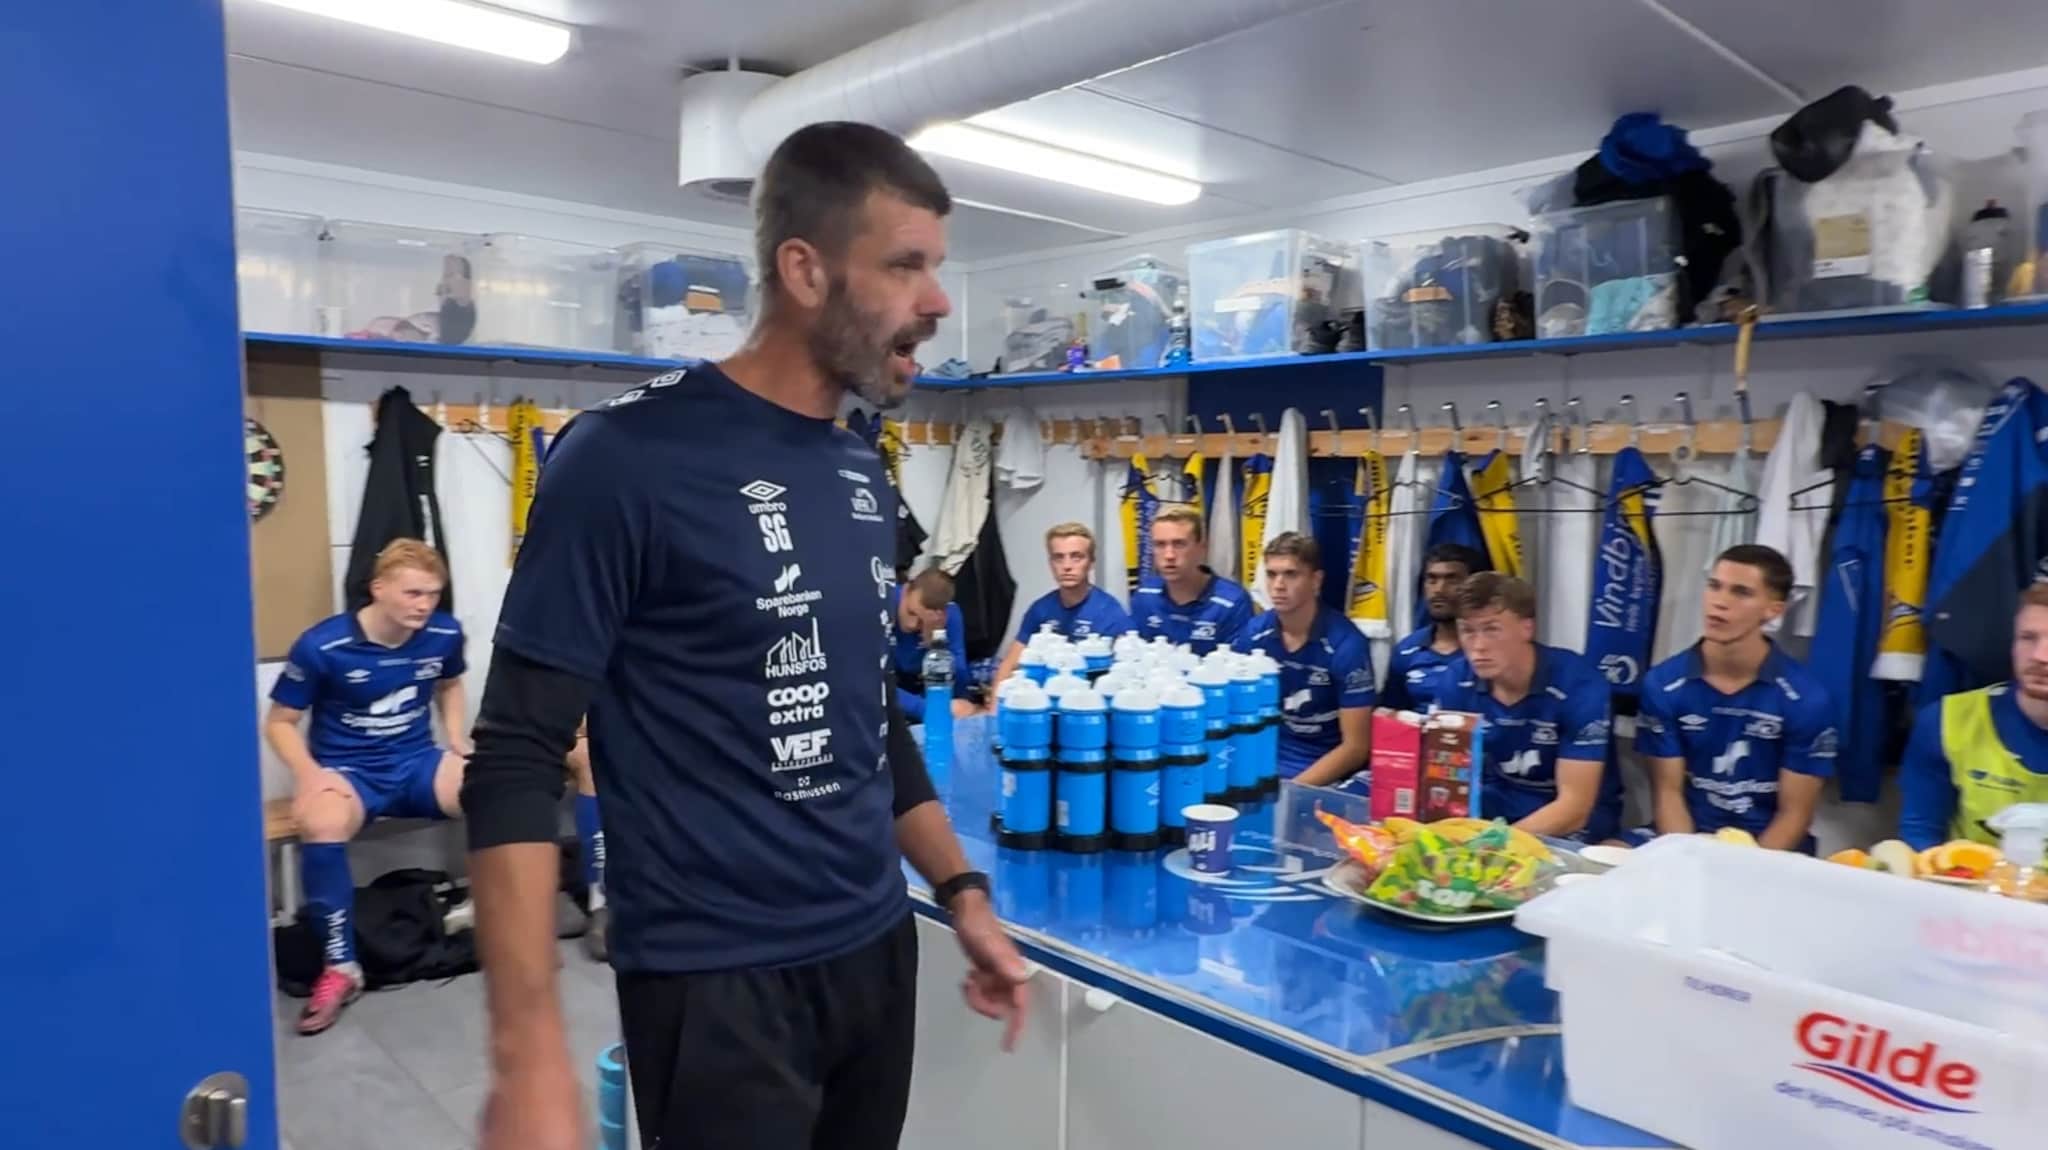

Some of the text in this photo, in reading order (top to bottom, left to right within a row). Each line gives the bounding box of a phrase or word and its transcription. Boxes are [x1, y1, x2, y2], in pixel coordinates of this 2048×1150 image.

[748, 501, 788, 514] umbro
[758, 513, 794, 552] SG
[756, 590, 823, 611] Sparebanken
[778, 603, 810, 618] Norge
[765, 657, 827, 679] HUNSFOS
[767, 681, 830, 706] coop
[769, 704, 824, 726] extra
[770, 728, 832, 762] VEF
[1796, 1012, 1979, 1100] Gilde
